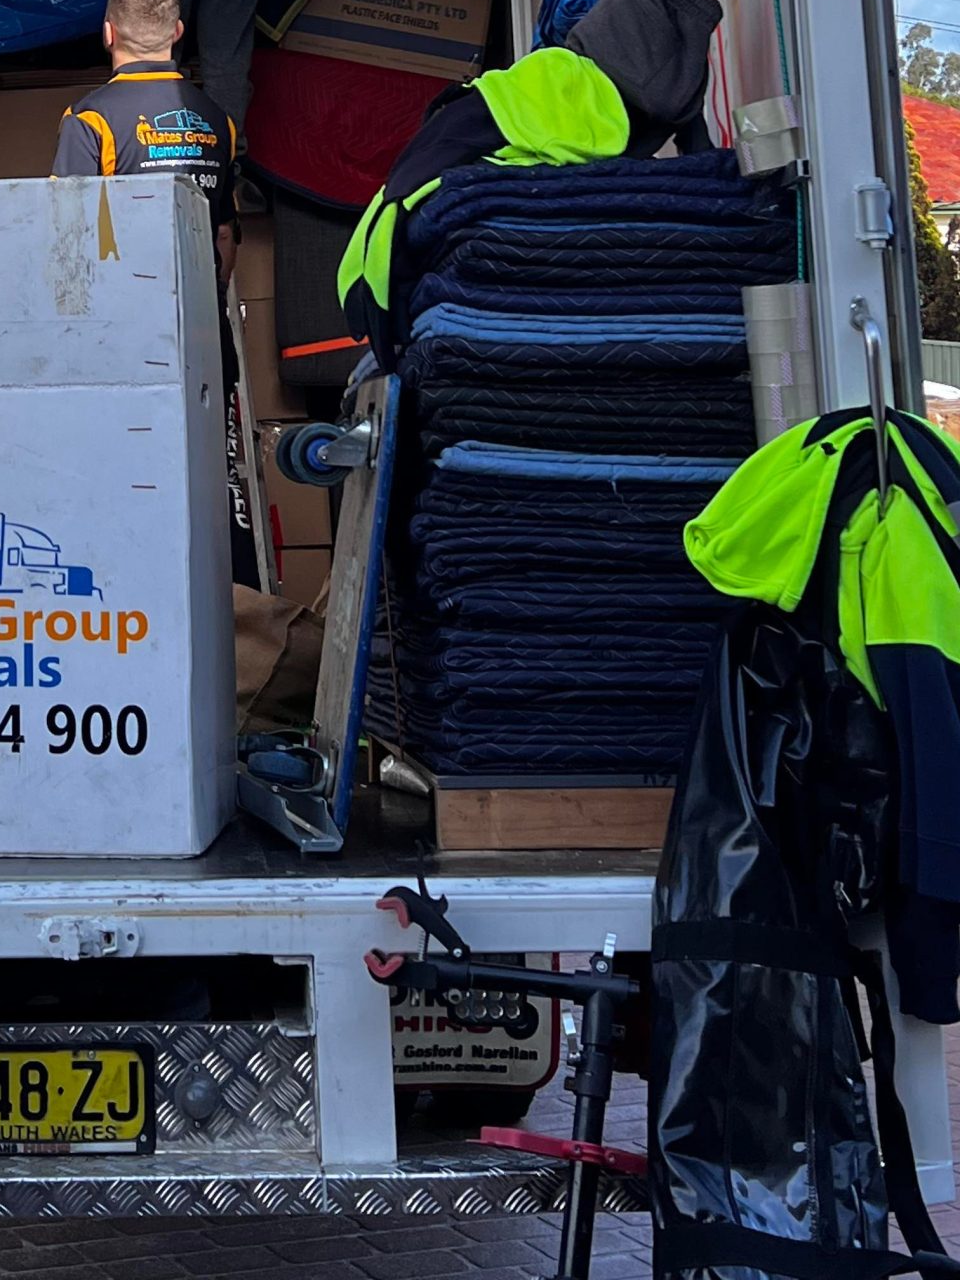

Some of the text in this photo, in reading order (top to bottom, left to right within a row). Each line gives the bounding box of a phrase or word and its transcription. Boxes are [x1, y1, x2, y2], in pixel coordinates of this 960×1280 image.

[341, 3, 378, 20] PLASTIC
[444, 6, 468, 20] LTD
[146, 131, 218, 147] Mates Group
[149, 144, 203, 159] Removals
[199, 173, 218, 189] 900
[45, 703, 149, 757] 900
[403, 1044, 464, 1059] Gosford
[471, 1045, 539, 1061] Narellan
[51, 1124, 118, 1141] WALES
